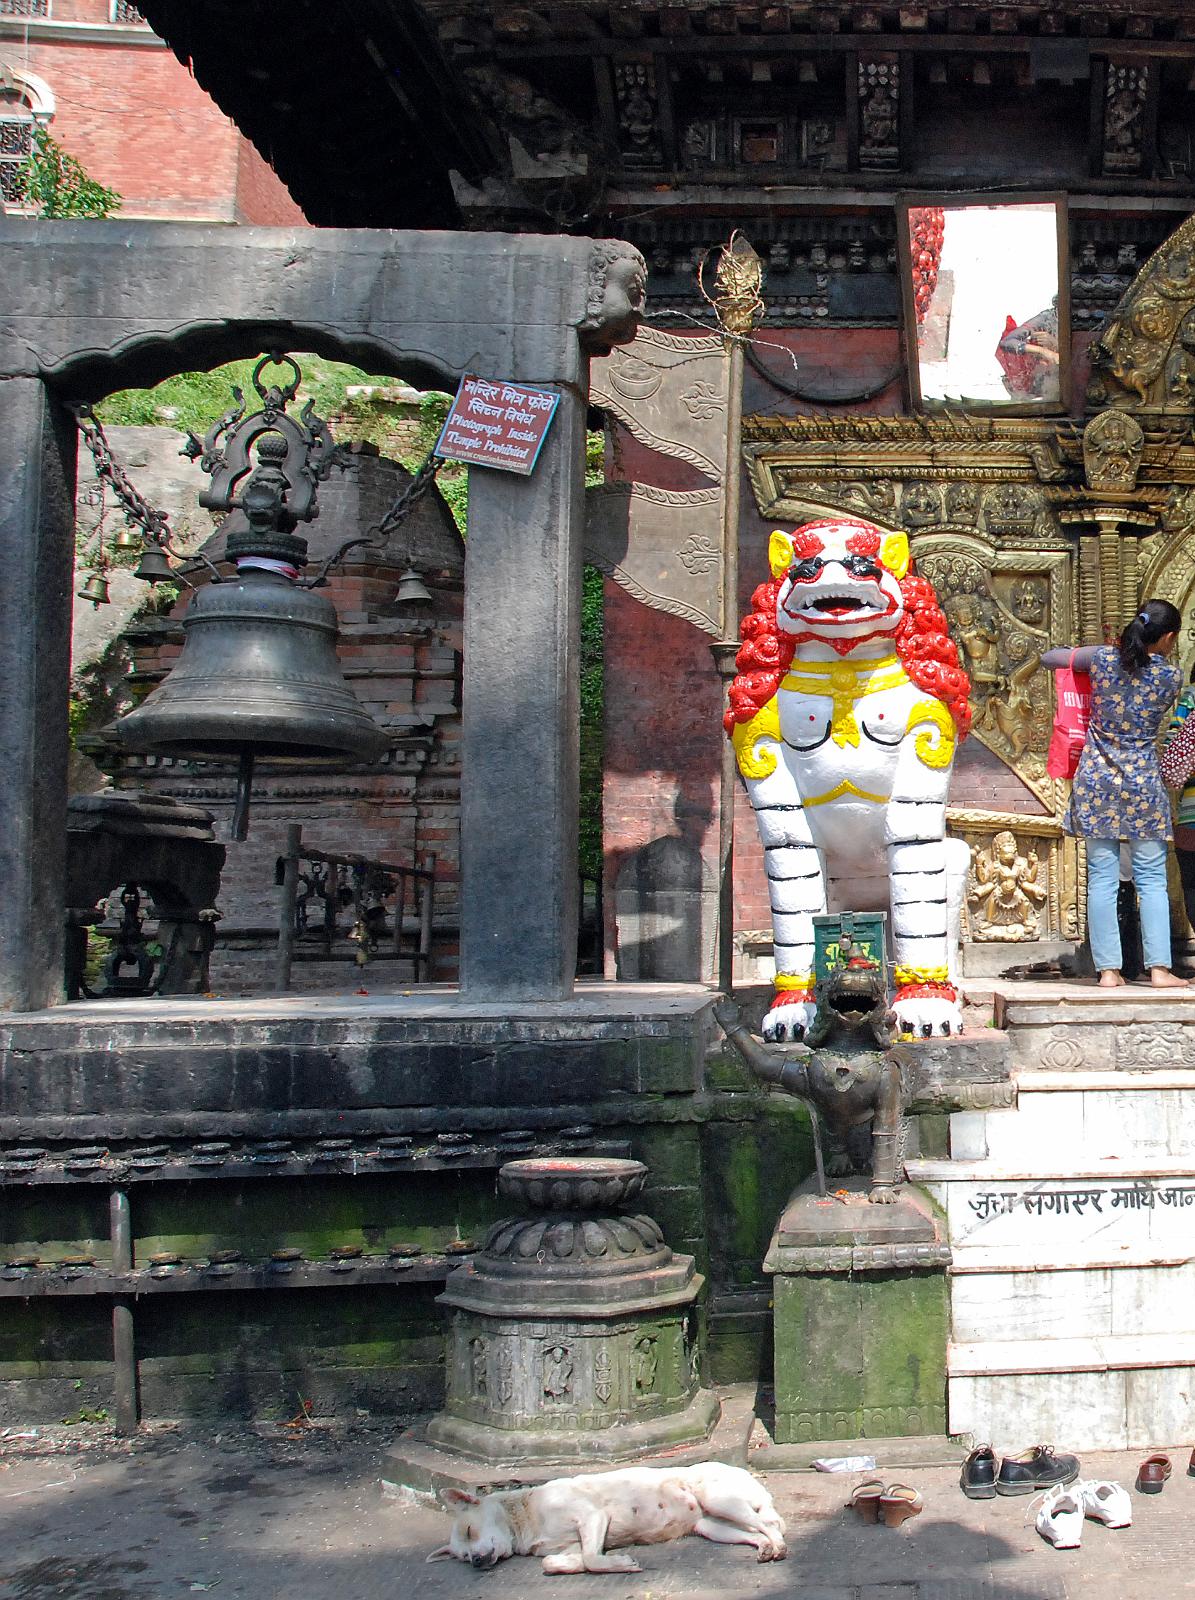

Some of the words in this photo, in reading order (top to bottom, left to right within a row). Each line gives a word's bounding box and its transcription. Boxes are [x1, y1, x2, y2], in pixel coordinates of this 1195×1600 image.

[465, 379, 501, 402] मन्दिर
[501, 386, 528, 407] भित्र
[527, 394, 555, 413] फोटो
[450, 414, 503, 438] Photograph
[507, 427, 538, 443] Inside
[447, 431, 482, 452] Temple
[484, 439, 530, 460] Prohibited
